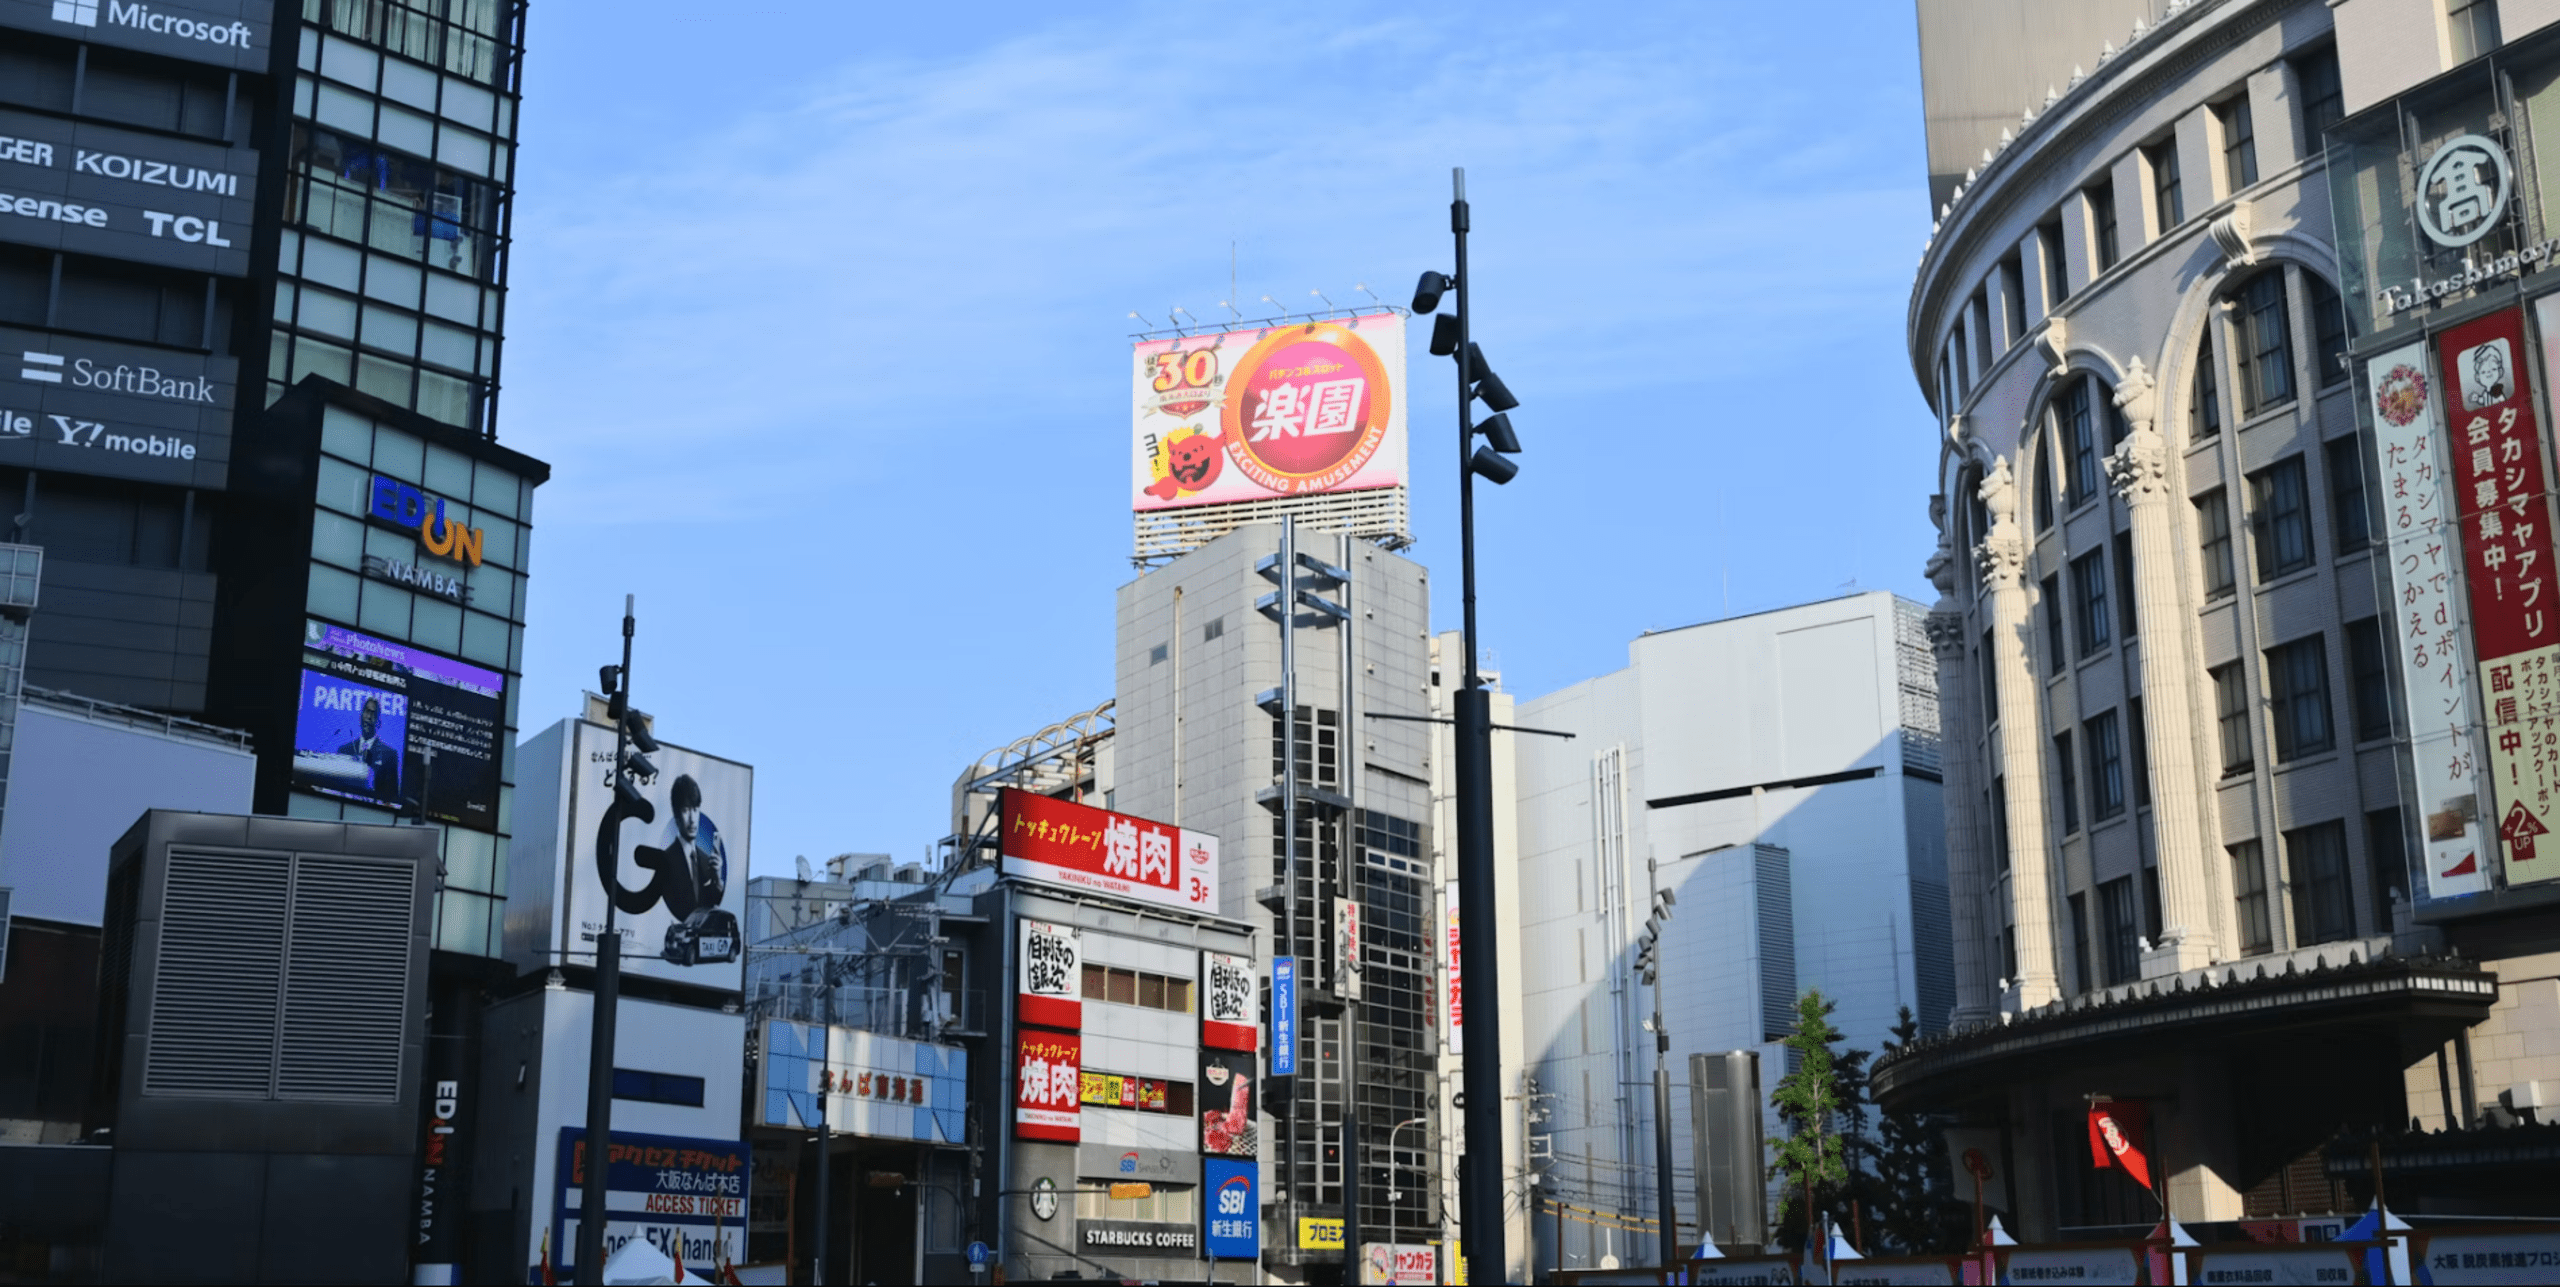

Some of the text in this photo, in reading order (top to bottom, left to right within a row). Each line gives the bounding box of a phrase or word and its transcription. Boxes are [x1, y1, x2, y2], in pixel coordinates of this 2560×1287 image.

[108, 0, 251, 49] Microsoft
[75, 150, 237, 196] KOIZUMI
[143, 210, 231, 248] TCL
[72, 358, 214, 402] SoftBank
[1152, 347, 1218, 392] 30
[1249, 377, 1365, 442] 楽園
[48, 414, 197, 460] Y!mobile
[1229, 426, 1385, 494] EXCITING AMUSEMENT
[369, 475, 484, 567] EDION
[2466, 415, 2507, 601] 会員募集中!
[2497, 407, 2545, 638] タカシマヤアプリ
[387, 559, 459, 598] NAMBA
[2412, 435, 2472, 781] タカシマヤでdポイントが
[2490, 664, 2522, 785] 配信中!
[2521, 659, 2551, 816] ポイントアップクーポン
[1103, 815, 1172, 885] 焼肉
[2514, 835, 2532, 850] UP
[1189, 876, 1209, 903] 3F
[1020, 1054, 1078, 1108] 焼肉
[608, 1143, 744, 1173] アクセスチケット
[656, 1169, 741, 1193] 大阪なんば本店
[1218, 1189, 1246, 1215] SBI
[418, 1168, 436, 1245] NAMBA
[645, 1194, 741, 1216] ACCESS TICKET
[1086, 1229, 1194, 1247] STARBUCKS COFFEE
[1211, 1219, 1253, 1239] 新生銀行
[1394, 1251, 1434, 1271] ャンカラ
[2433, 1253, 2460, 1270] 大阪
